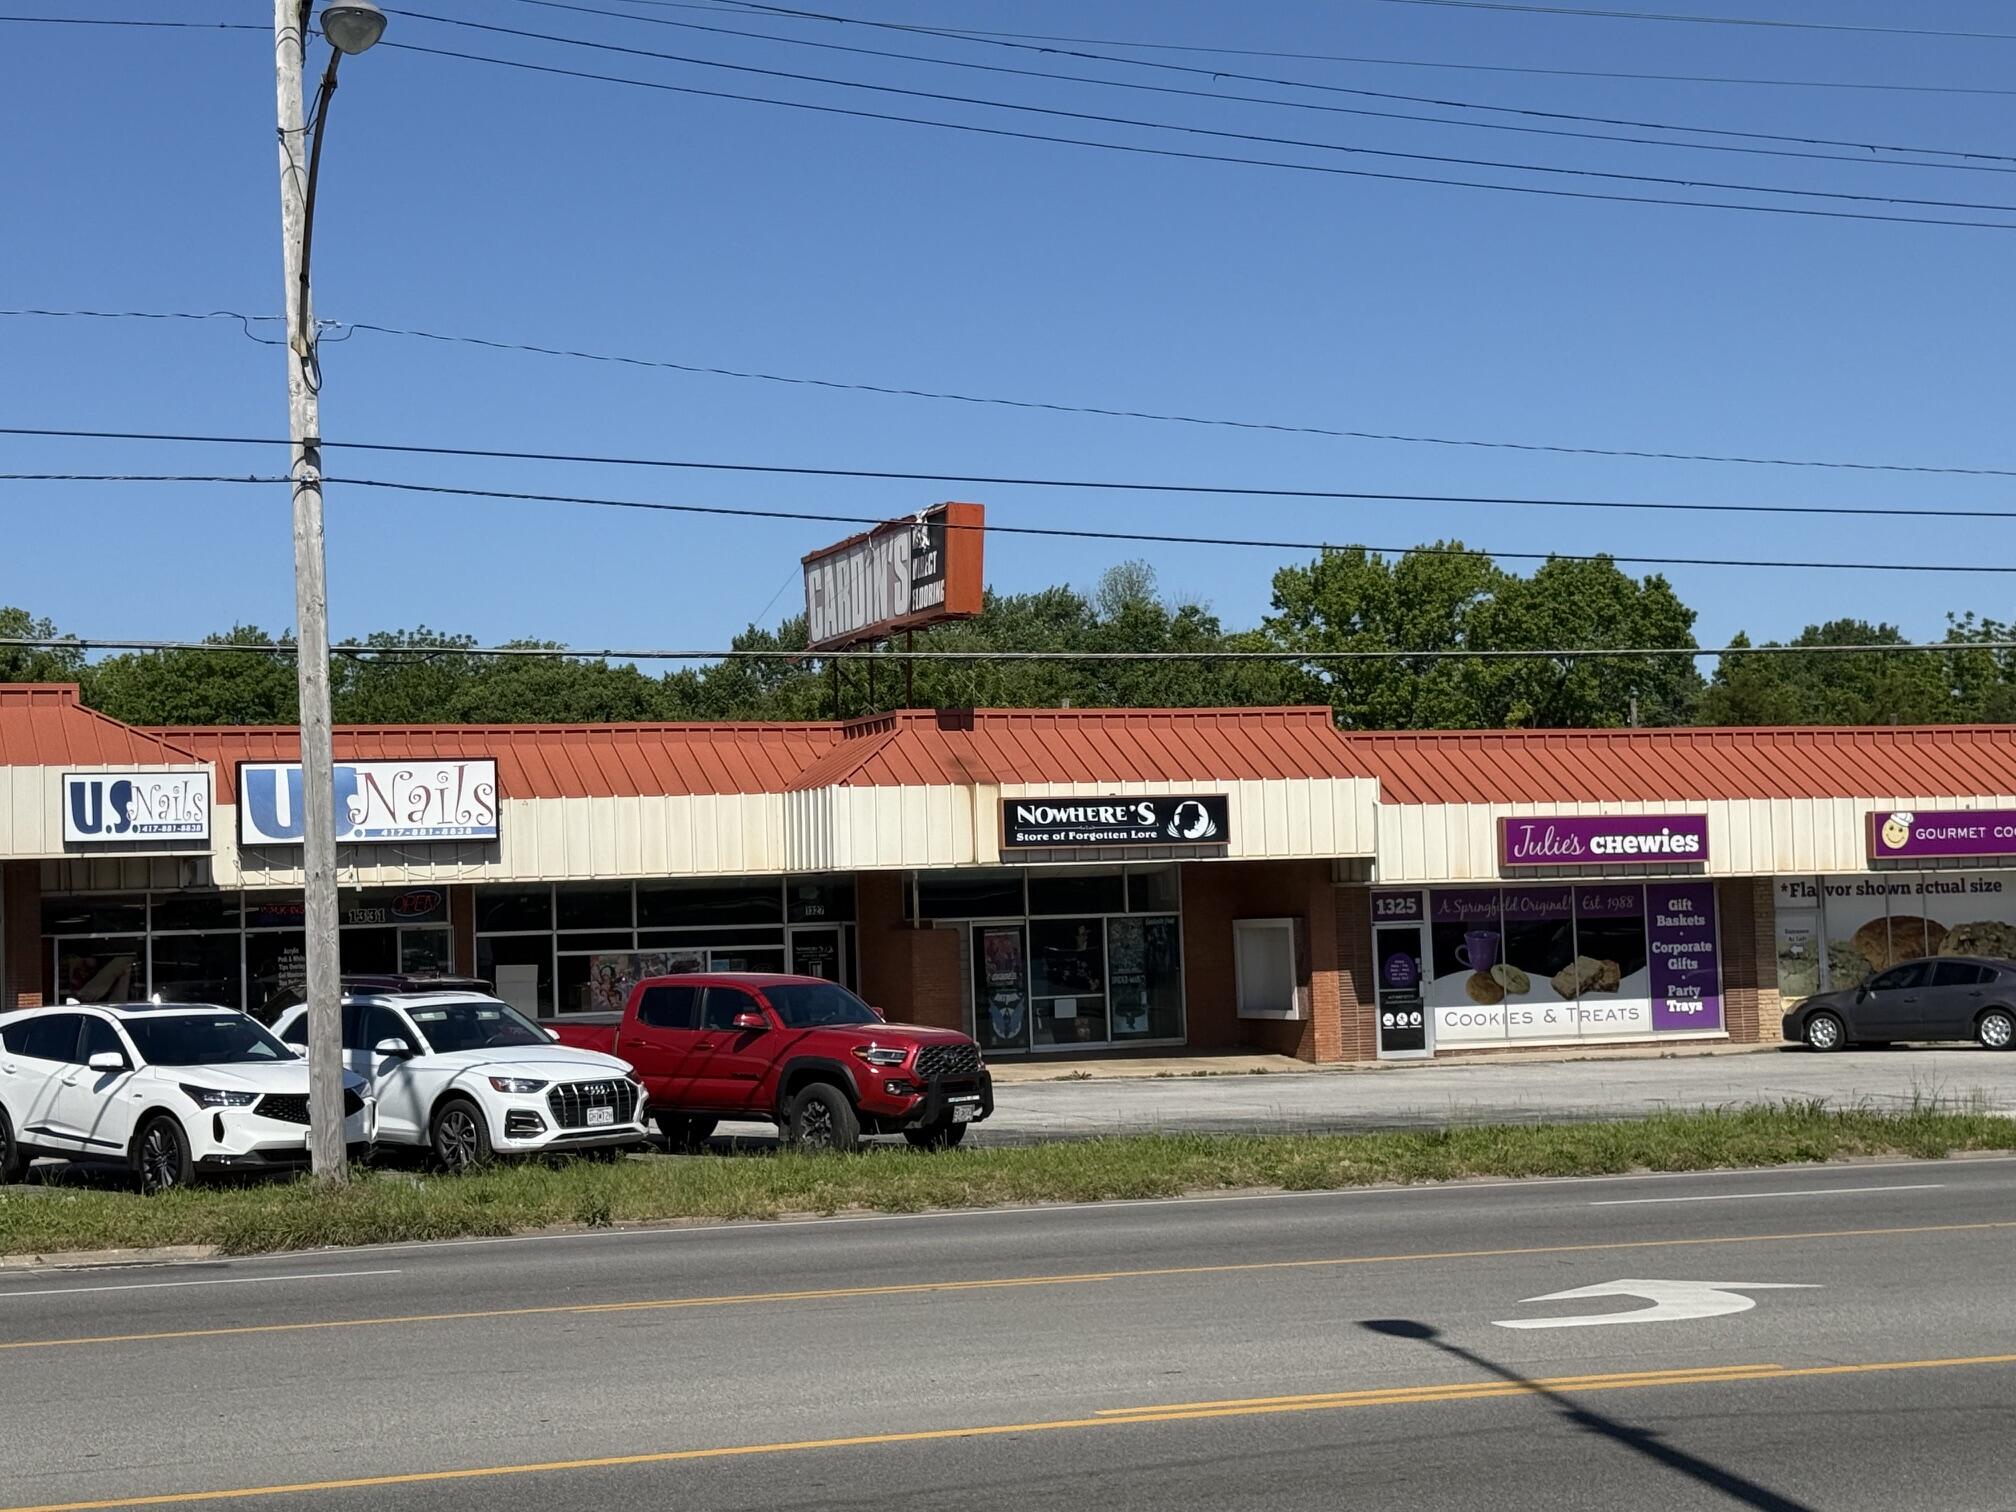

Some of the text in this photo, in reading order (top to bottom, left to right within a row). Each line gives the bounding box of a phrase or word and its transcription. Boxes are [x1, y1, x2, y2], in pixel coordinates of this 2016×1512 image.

[912, 579, 945, 612] FLOORING
[347, 764, 494, 825] Nails
[70, 780, 203, 834] U.S. Nails
[1016, 802, 1157, 826] NOWHERE'S
[1016, 828, 1158, 842] Store of Forgotten Lore
[1915, 826, 1987, 840] GOURMET
[1514, 825, 1585, 858] Julie's
[1856, 878, 1911, 896] shown
[1916, 877, 1966, 895] actual
[1970, 877, 2003, 893] size
[395, 895, 437, 912] OPEN
[1376, 898, 1417, 915] 1325
[1607, 895, 1634, 911] 1988
[1668, 899, 1692, 911] Gift
[350, 909, 386, 923] 1331
[1656, 914, 1706, 926] Baskets
[1652, 942, 1712, 955] Corporate
[1668, 958, 1699, 970] Gifts
[1667, 985, 1701, 999] Party
[1666, 999, 1704, 1014] Trays
[1444, 1007, 1640, 1027] COOKIES & TREATS
